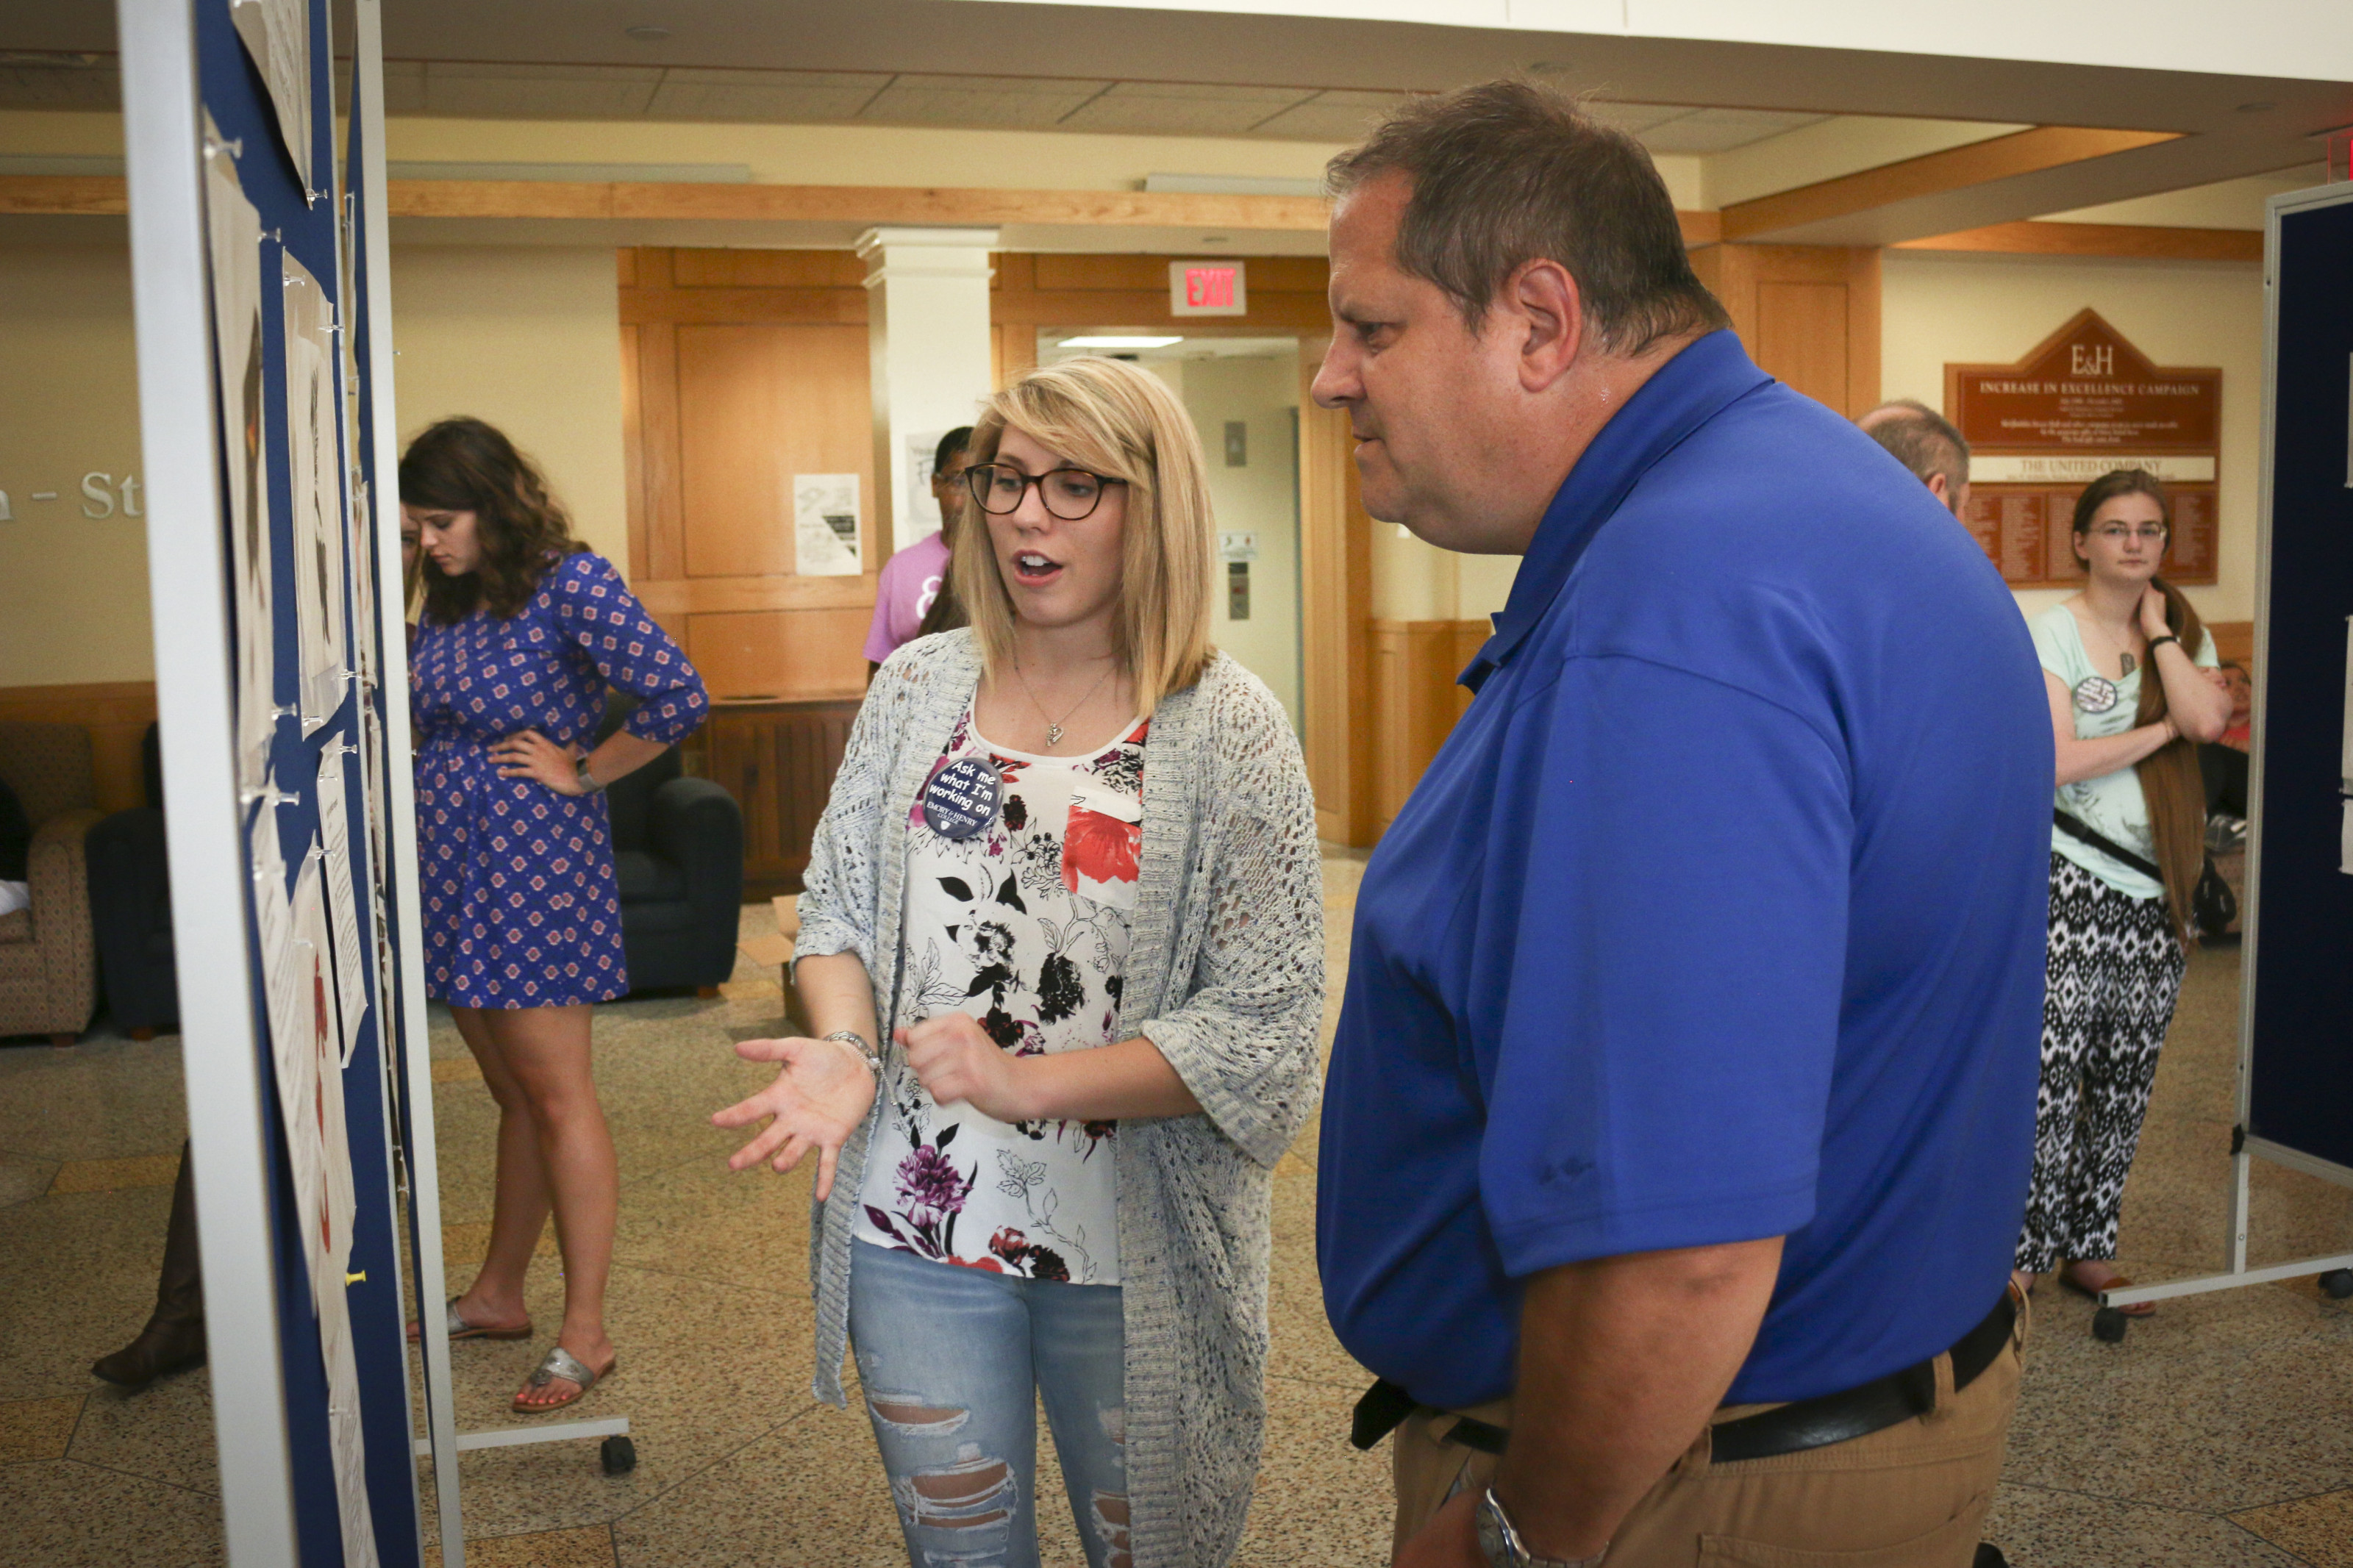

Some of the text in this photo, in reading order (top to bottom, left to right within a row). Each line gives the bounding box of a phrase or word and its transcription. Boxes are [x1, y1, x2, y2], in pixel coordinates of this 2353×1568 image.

[1185, 268, 1237, 307] EXIT
[2071, 344, 2114, 376] E&H
[1979, 382, 2199, 396] INCREASE IN EXCELLENCE CAMPAIGN
[2021, 459, 2043, 471] THE
[2049, 460, 2097, 472] UNITED
[951, 761, 996, 785] Ask me
[929, 784, 991, 817] working on
[940, 773, 993, 802] what I'm
[926, 801, 949, 815] EMORY
[953, 811, 978, 827] HENRY
[937, 813, 959, 825] COLLEGE
